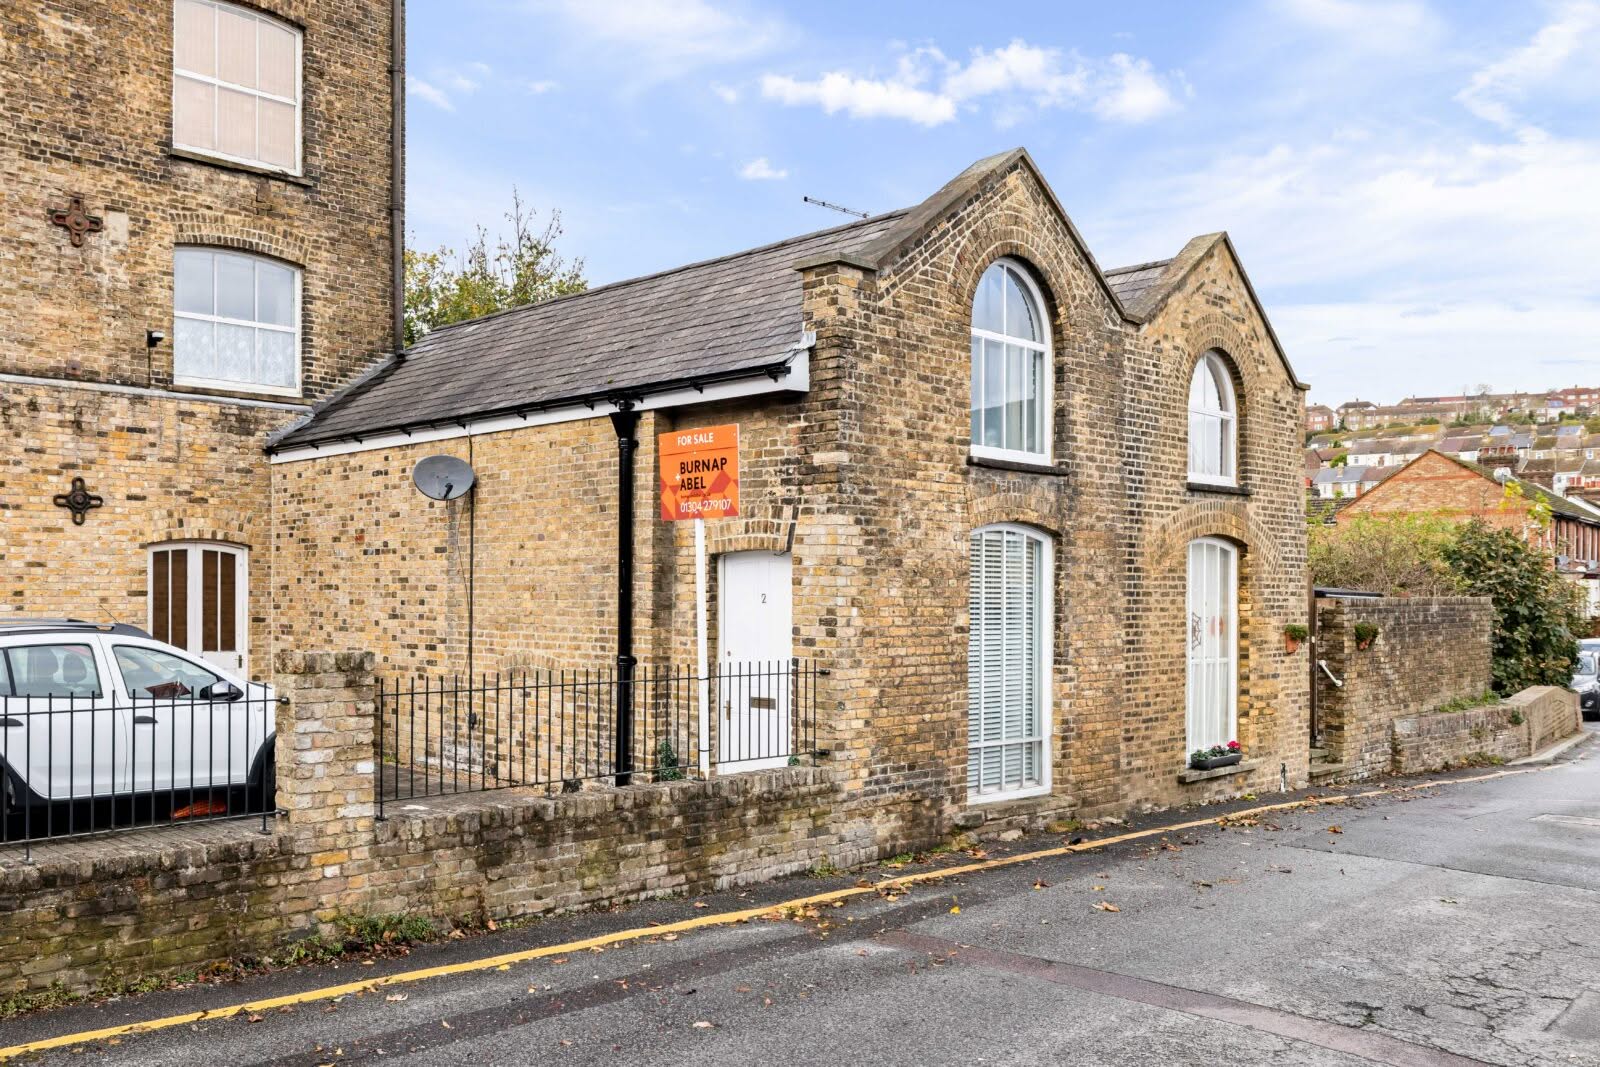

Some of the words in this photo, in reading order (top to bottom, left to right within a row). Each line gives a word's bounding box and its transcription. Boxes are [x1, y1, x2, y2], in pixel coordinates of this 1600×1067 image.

[677, 434, 692, 446] FOR
[694, 432, 714, 444] SALE
[680, 457, 727, 475] BURNAP
[680, 476, 706, 491] ABEL
[680, 501, 702, 513] 01304
[703, 499, 731, 511] 279107
[761, 593, 767, 603] 2
